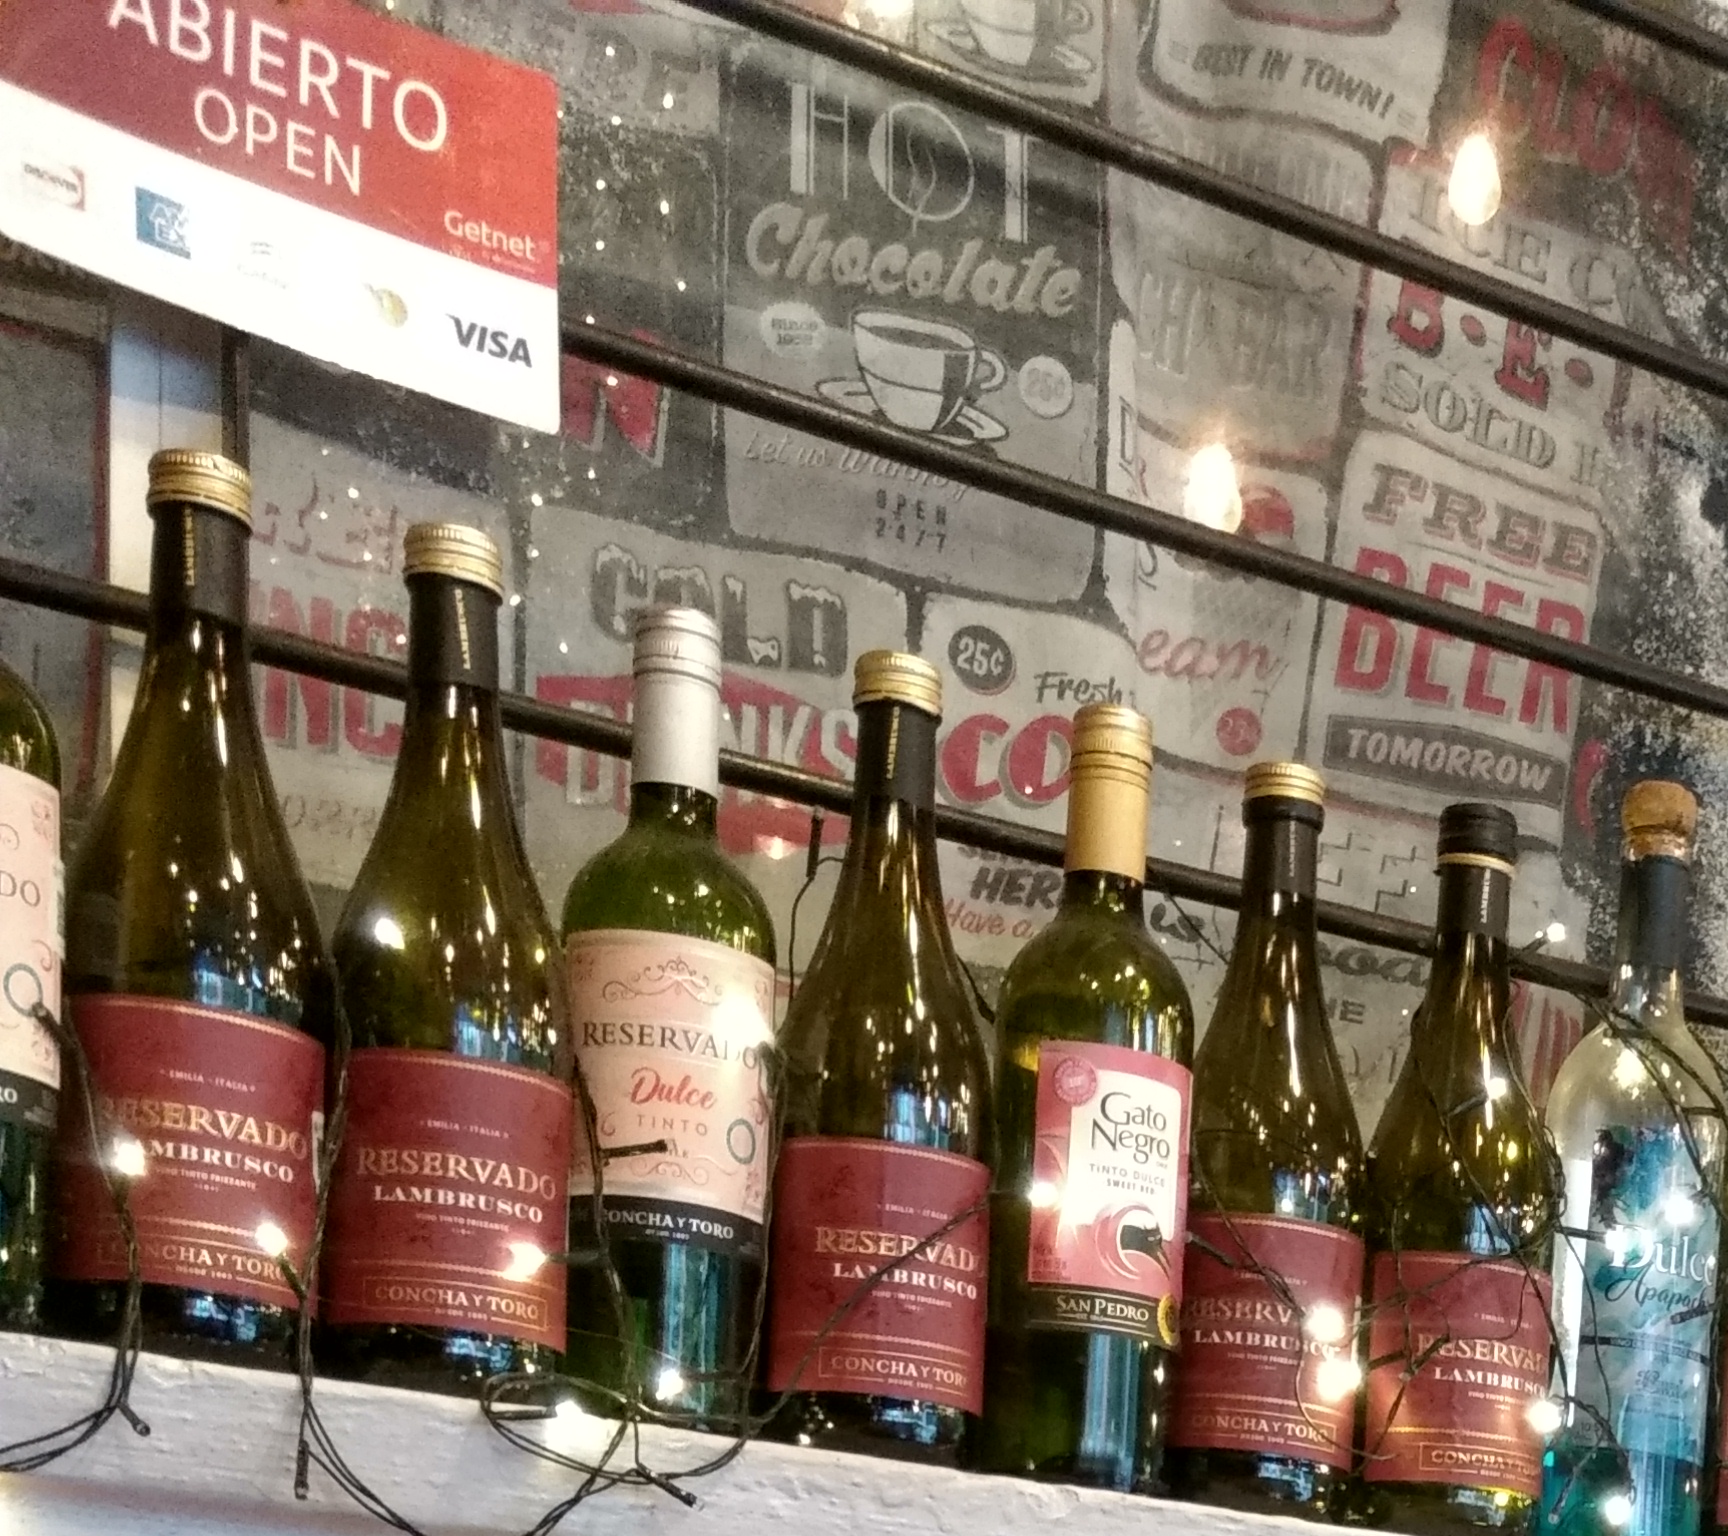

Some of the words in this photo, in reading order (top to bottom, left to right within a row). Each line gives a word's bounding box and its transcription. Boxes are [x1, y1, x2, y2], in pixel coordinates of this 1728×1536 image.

[106, 0, 447, 152] ABIERTO
[1258, 48, 1293, 81] IN
[1301, 57, 1396, 120] TOWN!
[193, 87, 361, 197] OPEN
[788, 83, 1046, 245] HOT
[443, 210, 536, 262] Getnet
[745, 202, 1083, 318] Chocolate
[445, 312, 533, 369] VISA
[1361, 463, 1601, 585] FREE
[956, 636, 1006, 678] 25¢
[1333, 545, 1586, 735] BEER
[1346, 727, 1553, 793] TOMORROW
[969, 866, 1063, 909] HER
[630, 1066, 718, 1109] Dulce
[637, 1113, 709, 1137] TINTO
[1100, 1091, 1167, 1133] Gato
[113, 1136, 295, 1184] MBRUSCO
[1091, 1117, 1171, 1165] Negro
[356, 1146, 557, 1201] RESERVADO
[1133, 1170, 1166, 1188] DULCE
[373, 1184, 544, 1225] LAMBRUSCO
[688, 1217, 735, 1241] TORO
[1608, 1224, 1717, 1286] Dulce
[374, 1285, 469, 1308] CONCHA
[472, 1294, 485, 1307] Y
[487, 1295, 540, 1321] TORO
[1055, 1294, 1091, 1314] SAN
[1094, 1297, 1150, 1323] PEDRO
[831, 1355, 918, 1378] CONCHA
